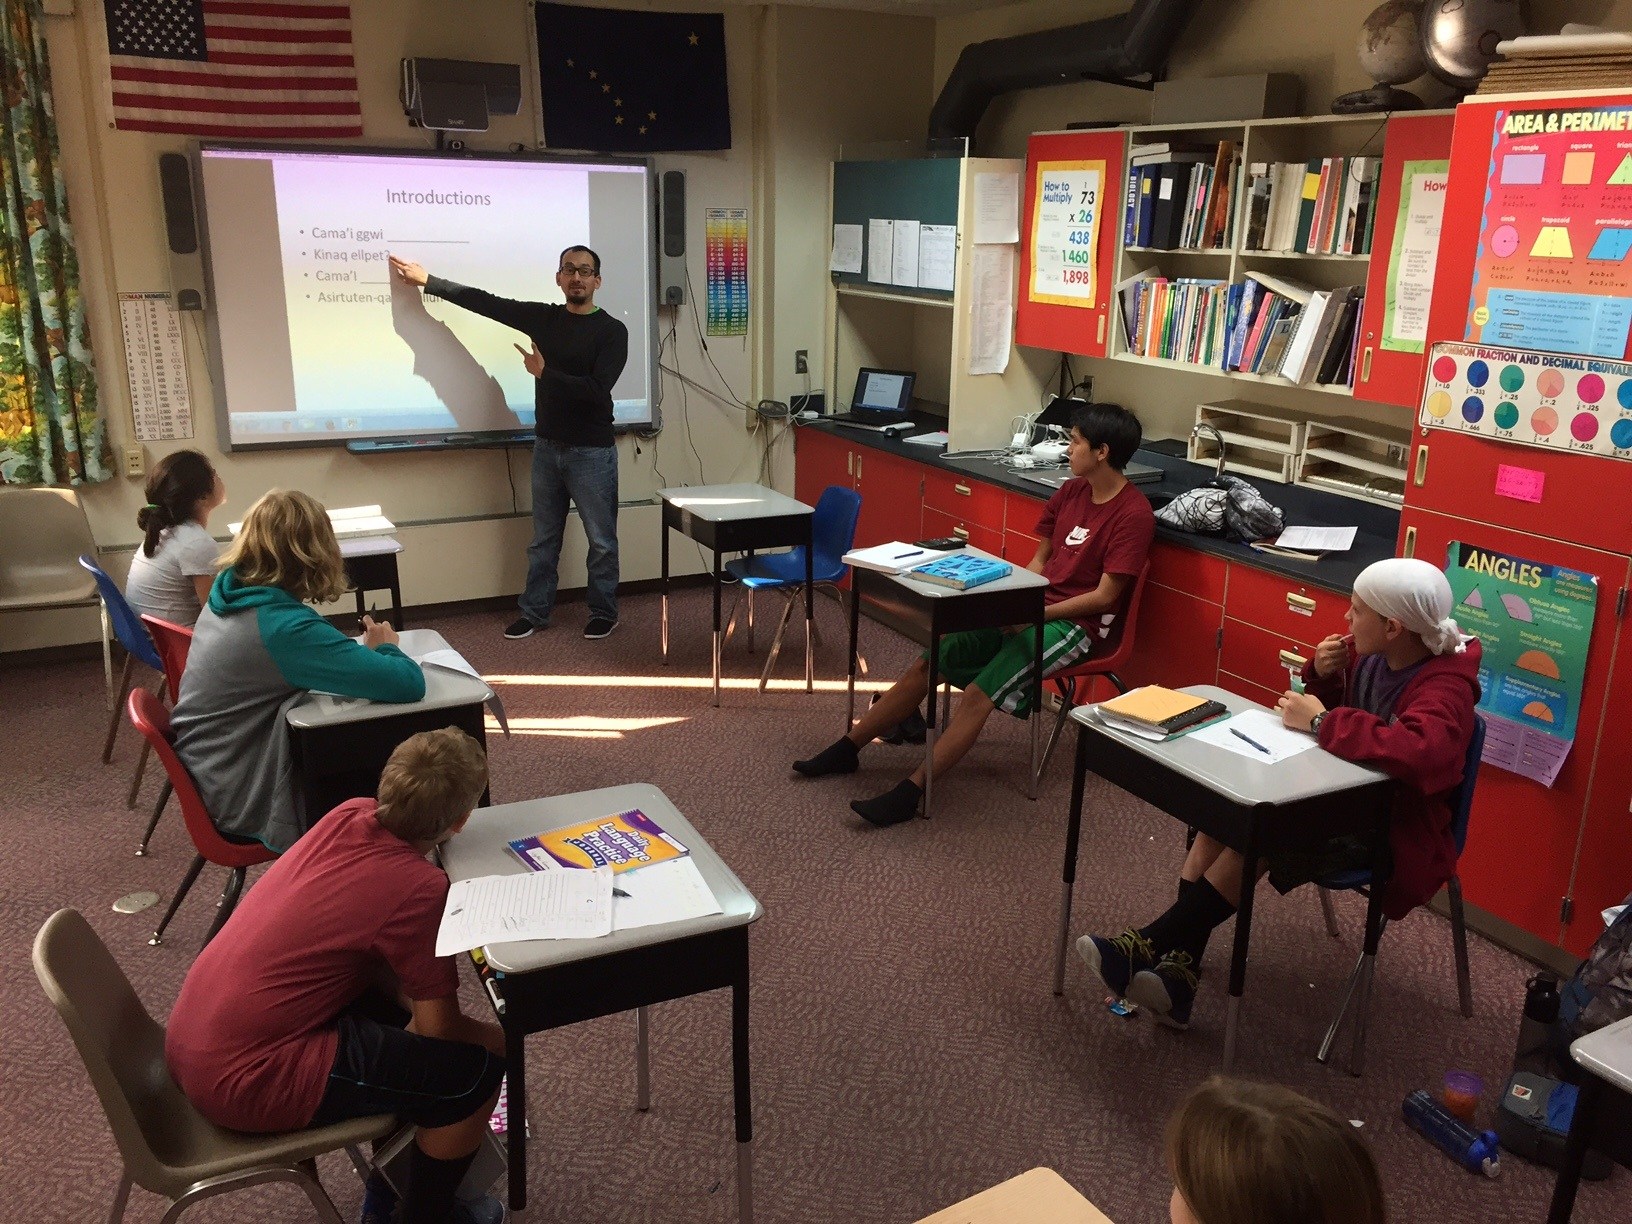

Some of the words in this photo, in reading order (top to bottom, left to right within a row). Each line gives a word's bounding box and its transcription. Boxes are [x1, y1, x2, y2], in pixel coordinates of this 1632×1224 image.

[1502, 114, 1544, 134] AREA
[1545, 112, 1559, 133] &
[1044, 181, 1059, 192] How
[1062, 182, 1070, 191] to
[1128, 176, 1137, 208] BIOLOGY
[1424, 180, 1447, 192] How
[387, 189, 491, 205] Introductions
[1043, 192, 1072, 205] Multiply
[1081, 191, 1095, 204] 73
[1069, 213, 1075, 222] x
[1079, 210, 1092, 223] 26
[1541, 216, 1570, 224] trapezoid
[312, 228, 353, 240] Cama'i
[356, 229, 383, 242] ggwi
[1069, 231, 1090, 245] 438
[314, 250, 348, 262] Kinaq
[351, 250, 390, 262] ellpet?
[1063, 270, 1089, 285] 1,898
[1435, 344, 1475, 357] COMMON
[1477, 348, 1517, 363] FRACTION
[1519, 353, 1540, 365] AND
[1542, 357, 1584, 371] DECIMAL
[1465, 550, 1542, 588] ANGLES
[1558, 570, 1580, 582] Angles
[1554, 588, 1568, 597] using
[1550, 603, 1570, 613] Angles
[598, 822, 651, 862] Language
[627, 830, 650, 847] Daily
[582, 831, 628, 864] Practice
